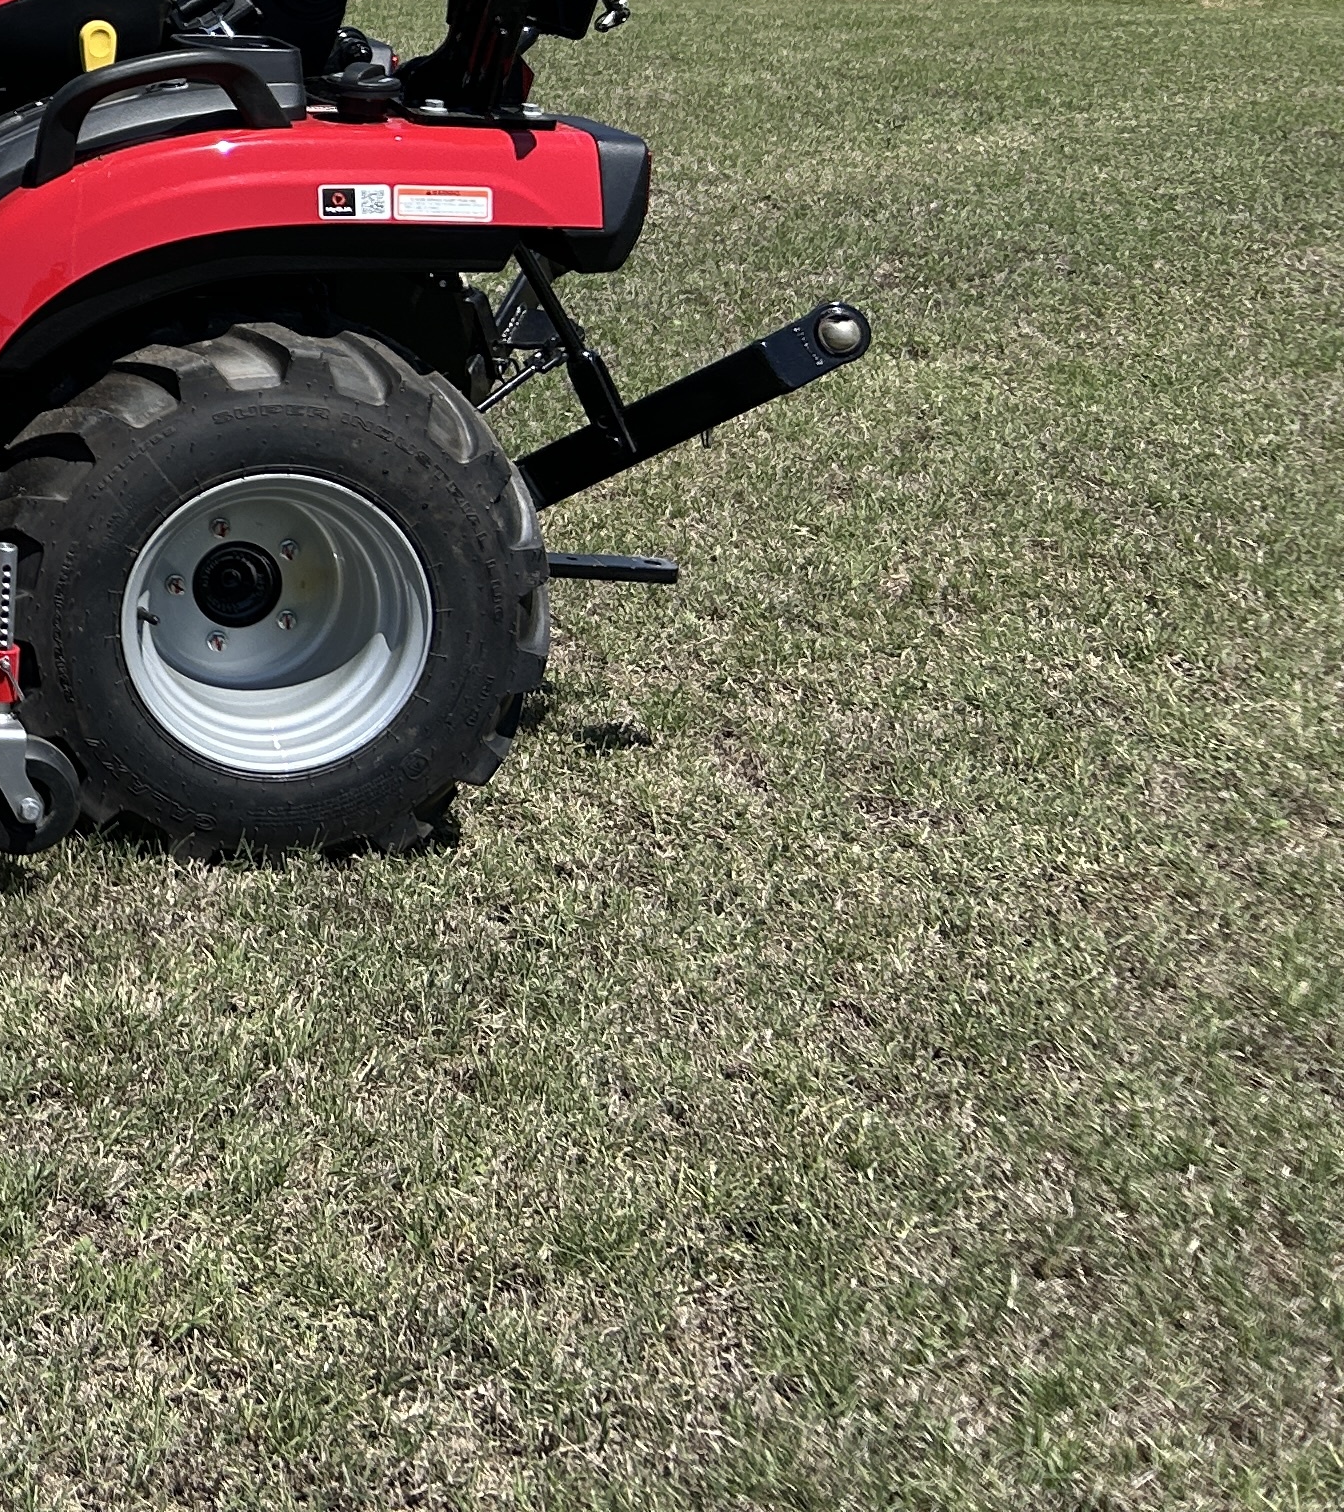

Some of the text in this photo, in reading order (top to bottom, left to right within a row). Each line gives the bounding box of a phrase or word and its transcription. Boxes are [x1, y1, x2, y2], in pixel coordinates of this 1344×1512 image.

[212, 403, 504, 621] SUPER INDUSTRIAL LUG
[83, 738, 218, 831] GALAXY
